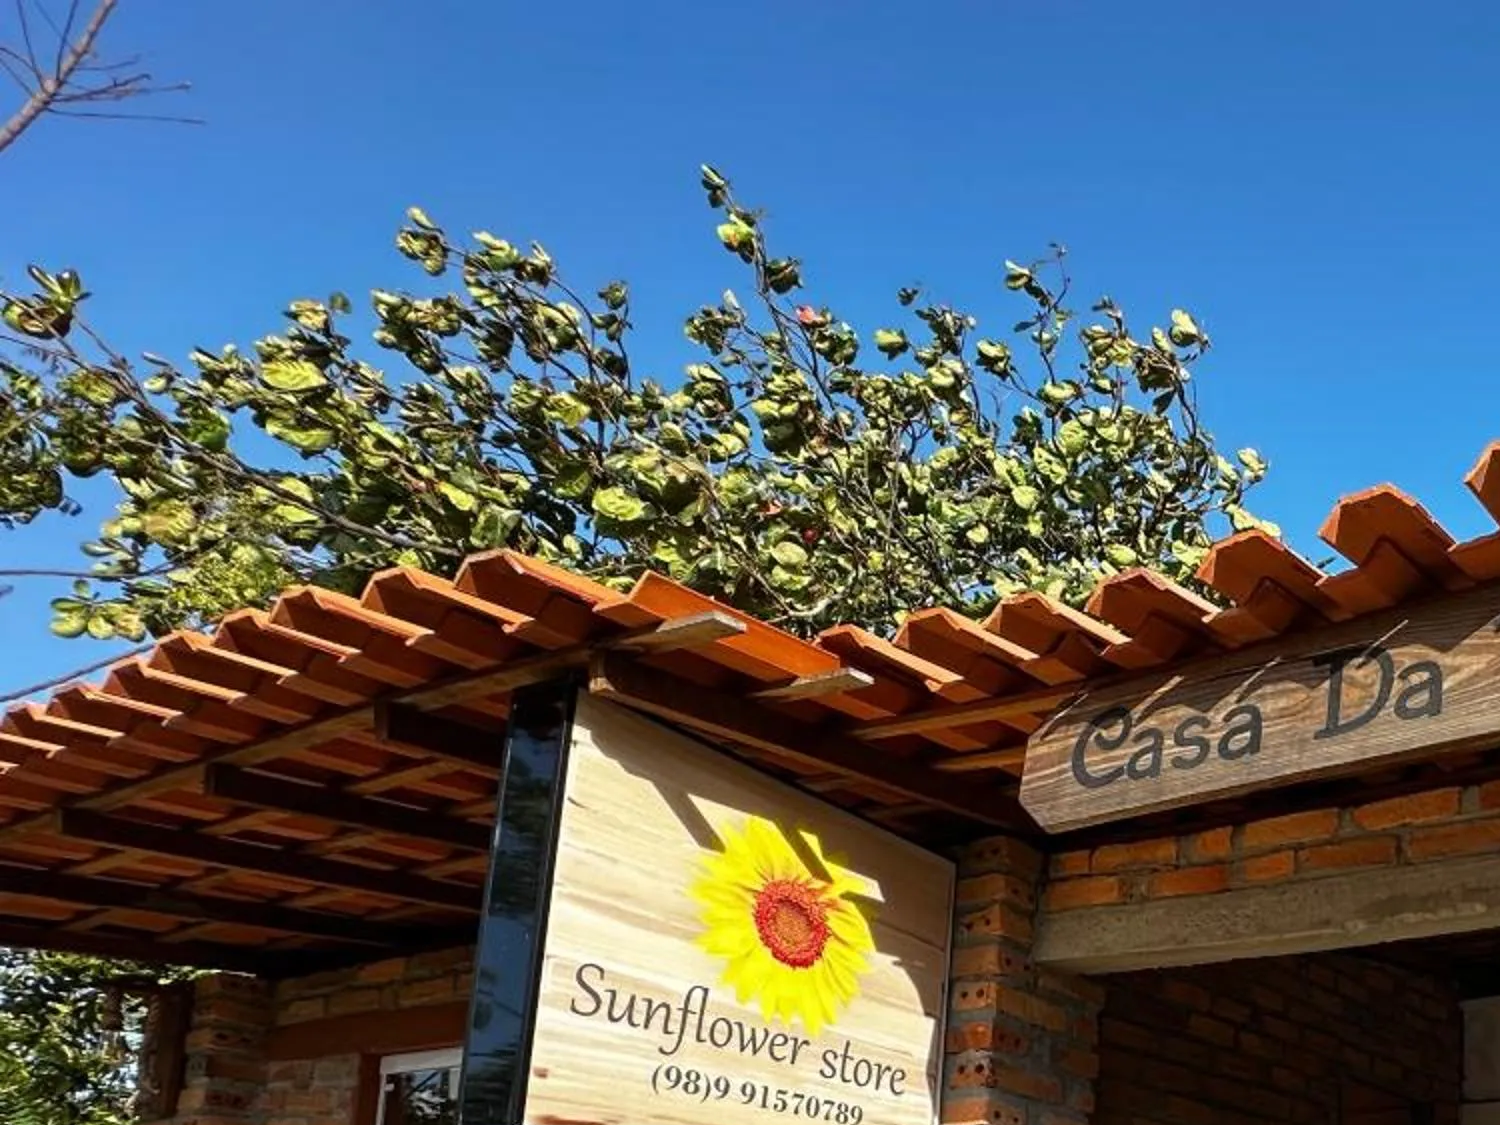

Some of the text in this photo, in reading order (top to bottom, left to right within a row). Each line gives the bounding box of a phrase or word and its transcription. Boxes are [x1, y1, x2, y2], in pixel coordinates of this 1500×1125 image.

[1072, 703, 1263, 789] Casa
[1312, 644, 1443, 741] Da
[570, 963, 907, 1097] Sunflower store
[651, 1064, 731, 1104] (98)9
